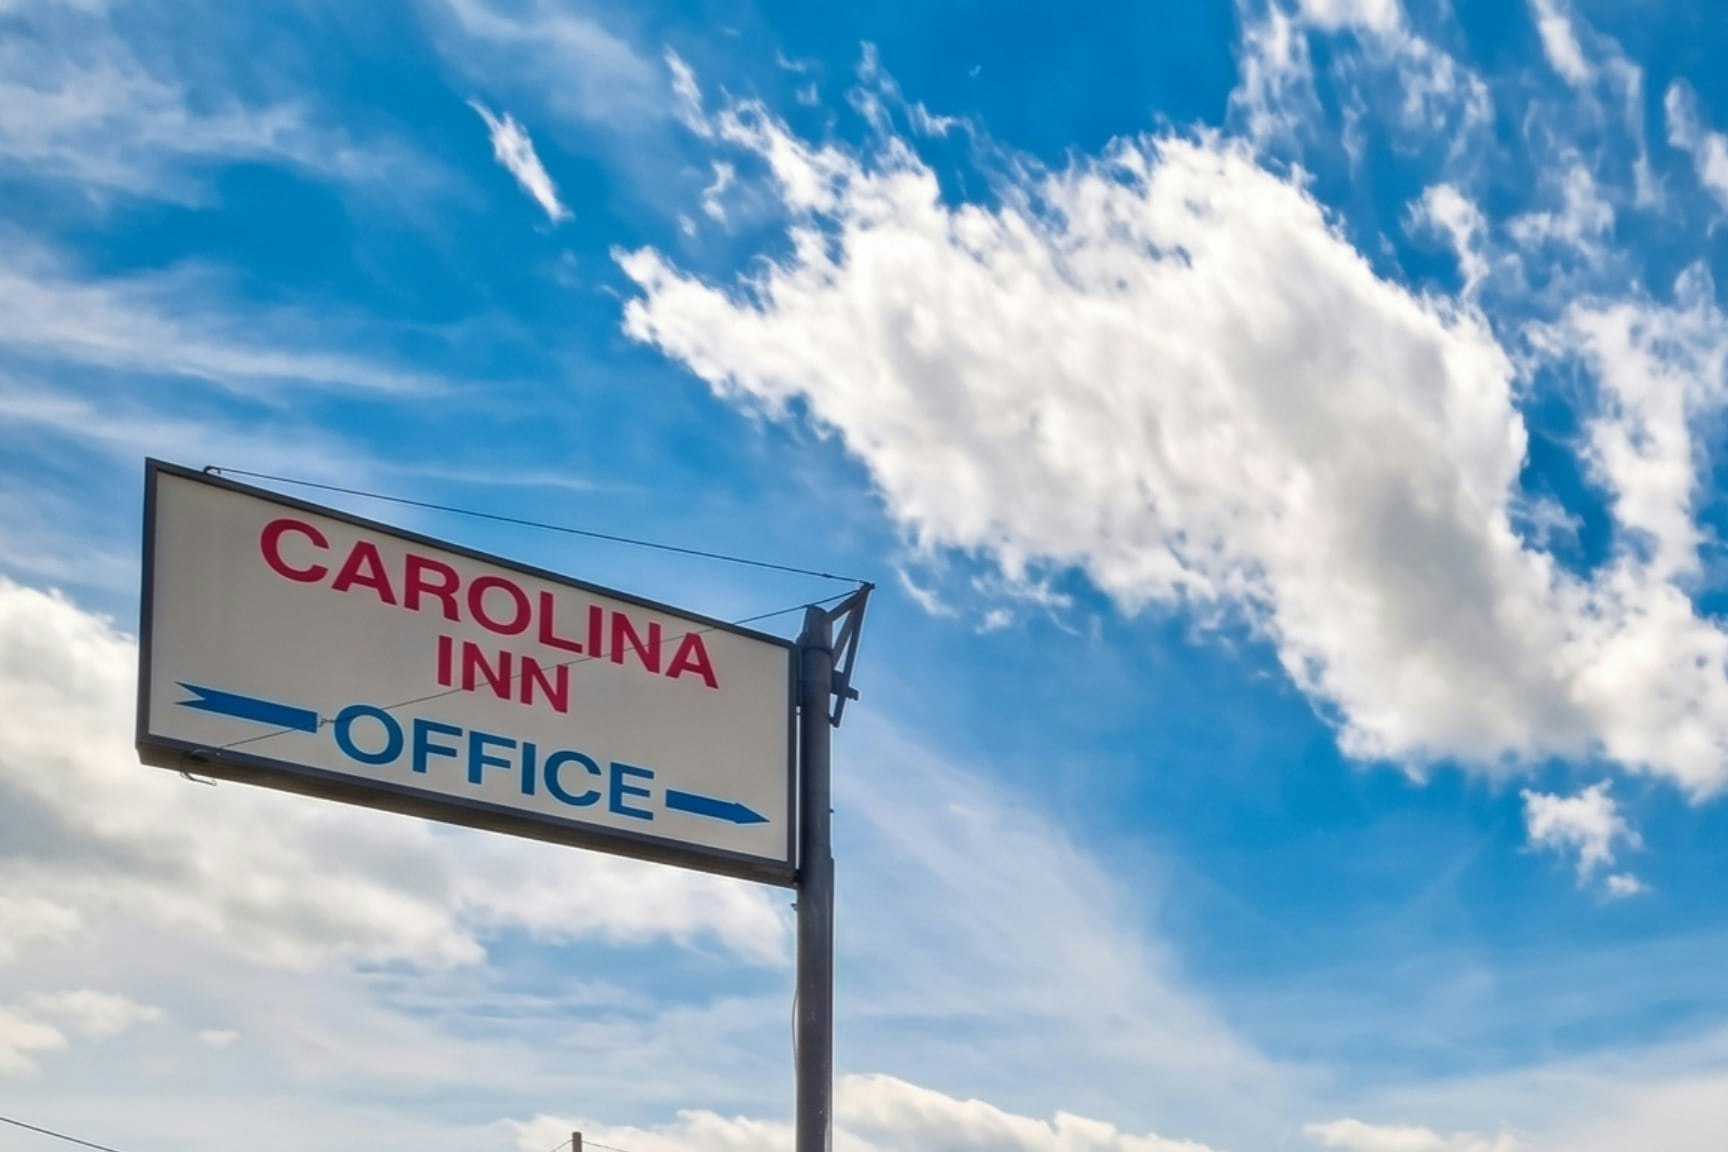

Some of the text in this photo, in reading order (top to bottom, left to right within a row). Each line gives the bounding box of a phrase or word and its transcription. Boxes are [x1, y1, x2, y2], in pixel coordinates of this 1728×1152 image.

[260, 517, 720, 690] CAROLINA
[436, 635, 569, 713] INN
[333, 703, 655, 821] OFFICE
